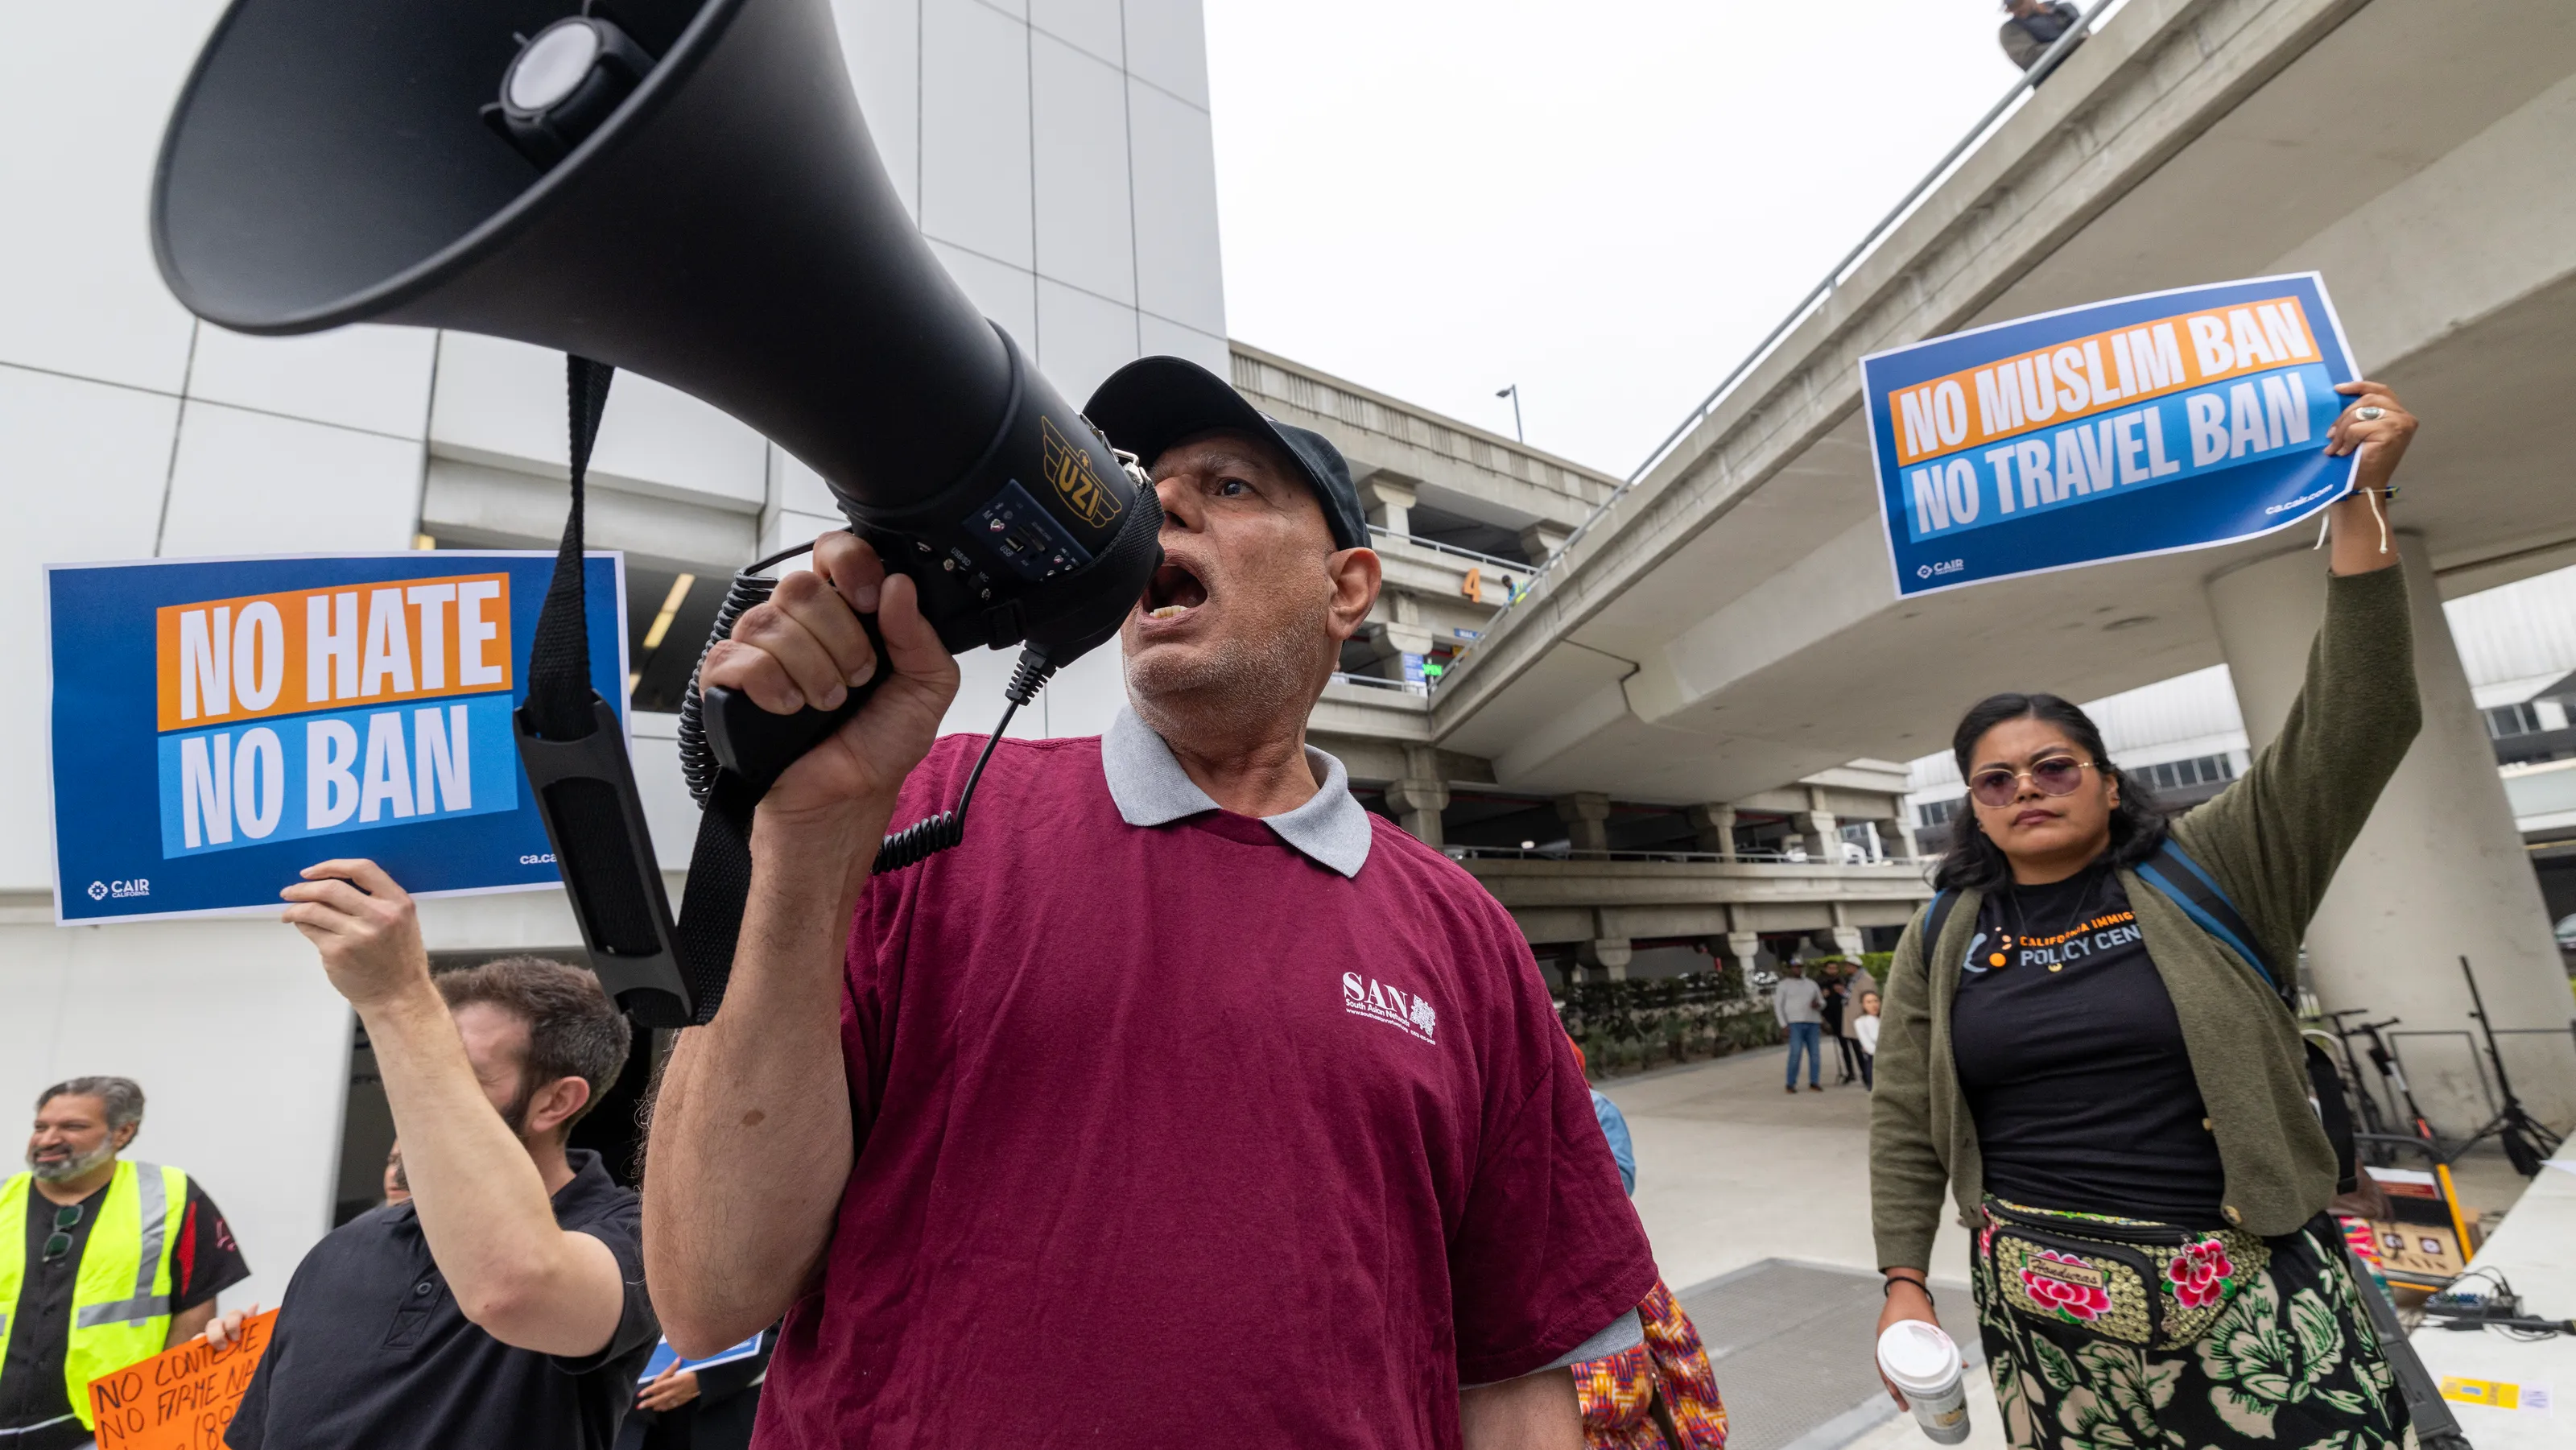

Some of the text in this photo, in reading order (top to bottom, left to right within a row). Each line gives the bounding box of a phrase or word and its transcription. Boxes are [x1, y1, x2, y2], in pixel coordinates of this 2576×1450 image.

[1900, 302, 2313, 457] NO MUSLIM BAN
[1910, 371, 2310, 535] NO TRAVEL BAN
[1059, 455, 1101, 518] UZI
[950, 546, 972, 567] USB/SD
[1000, 545, 1014, 557] USB
[1933, 558, 1964, 572] CAIR
[978, 571, 989, 583] MIC
[1462, 568, 1482, 603] 4
[180, 580, 503, 720] NO HATE
[180, 704, 473, 849] NO BAN
[111, 878, 150, 893] CAIR
[2019, 911, 2136, 947] CALIFORNIA IMMIG
[2020, 936, 2091, 966] POLICY
[1343, 971, 1408, 1019] SAN
[1345, 998, 1410, 1027] South Asian Network
[2030, 1258, 2098, 1284] Honduras
[97, 1372, 142, 1414] NO
[101, 1407, 145, 1449] NO
